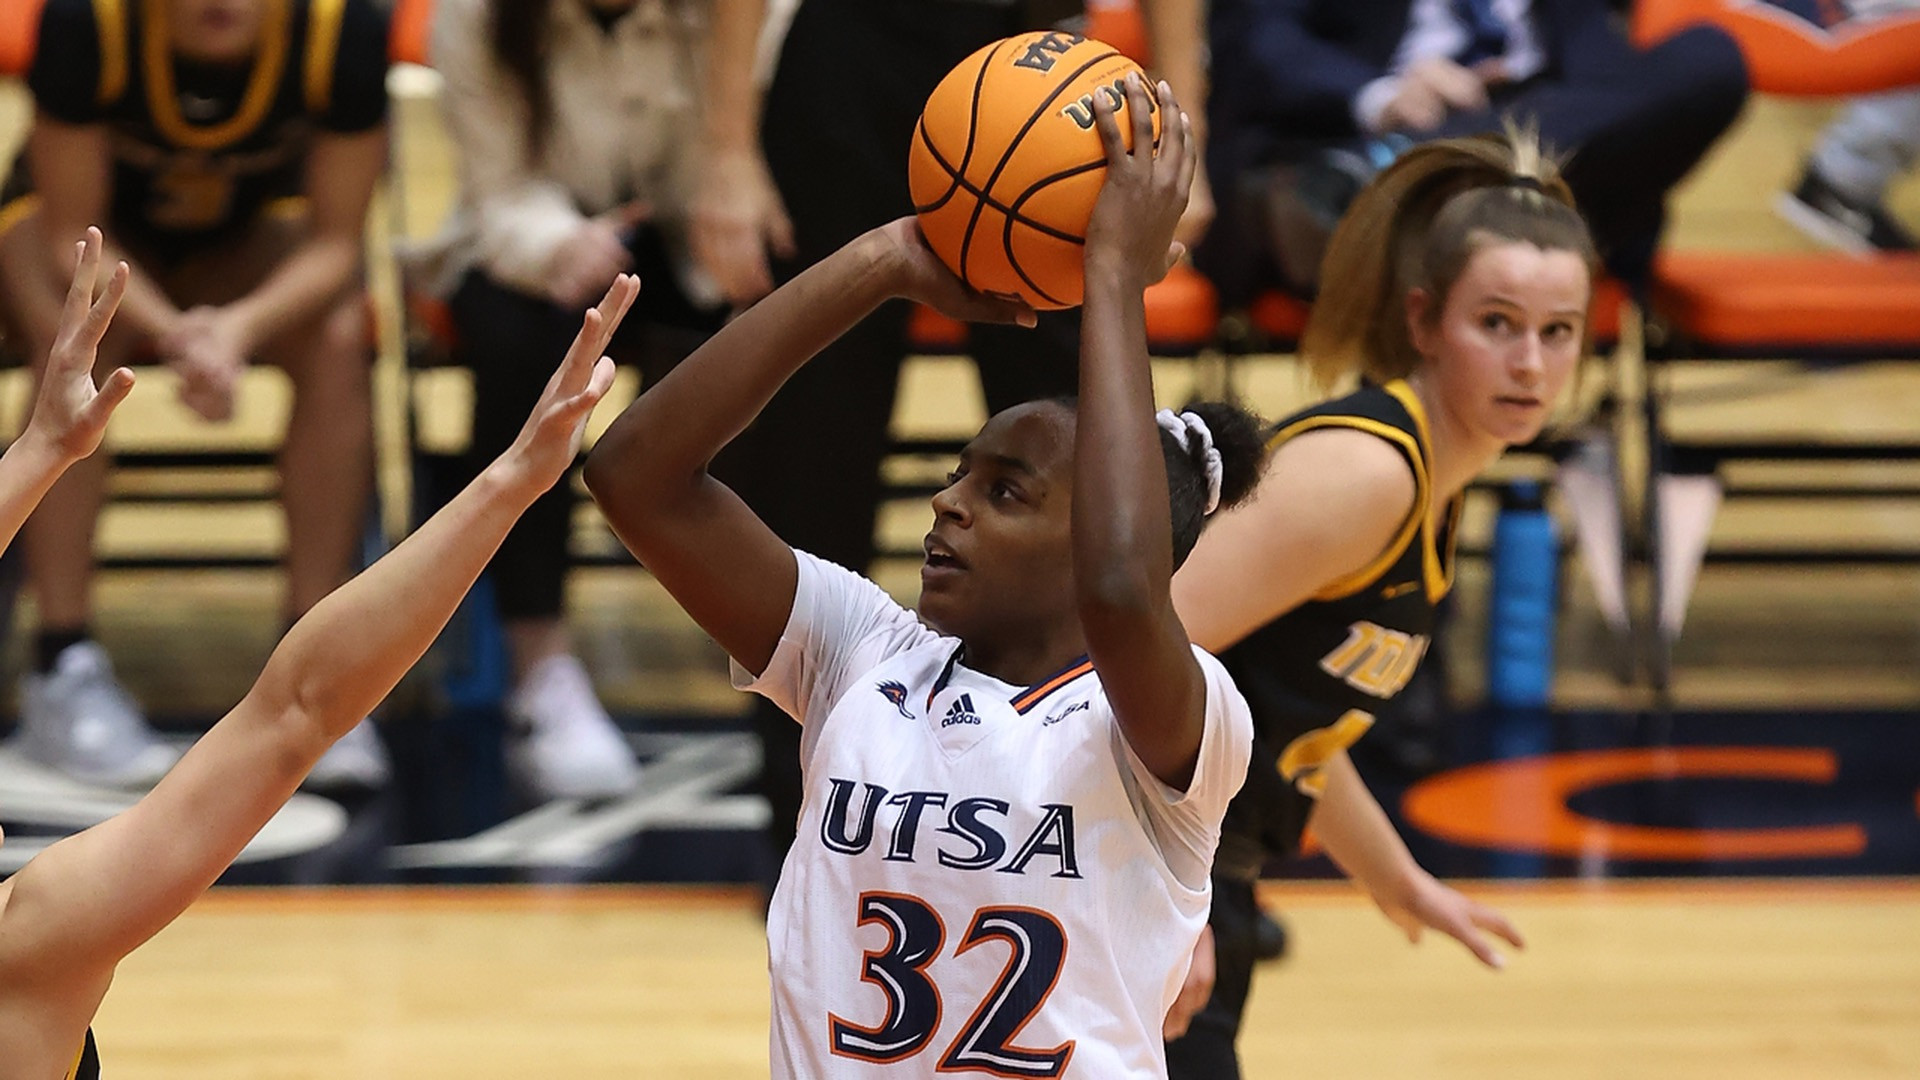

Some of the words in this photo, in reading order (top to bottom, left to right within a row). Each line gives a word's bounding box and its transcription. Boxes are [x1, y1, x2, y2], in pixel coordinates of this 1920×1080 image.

[941, 711, 981, 728] adidas
[820, 777, 1083, 879] UTSA
[828, 890, 1076, 1080] 32
